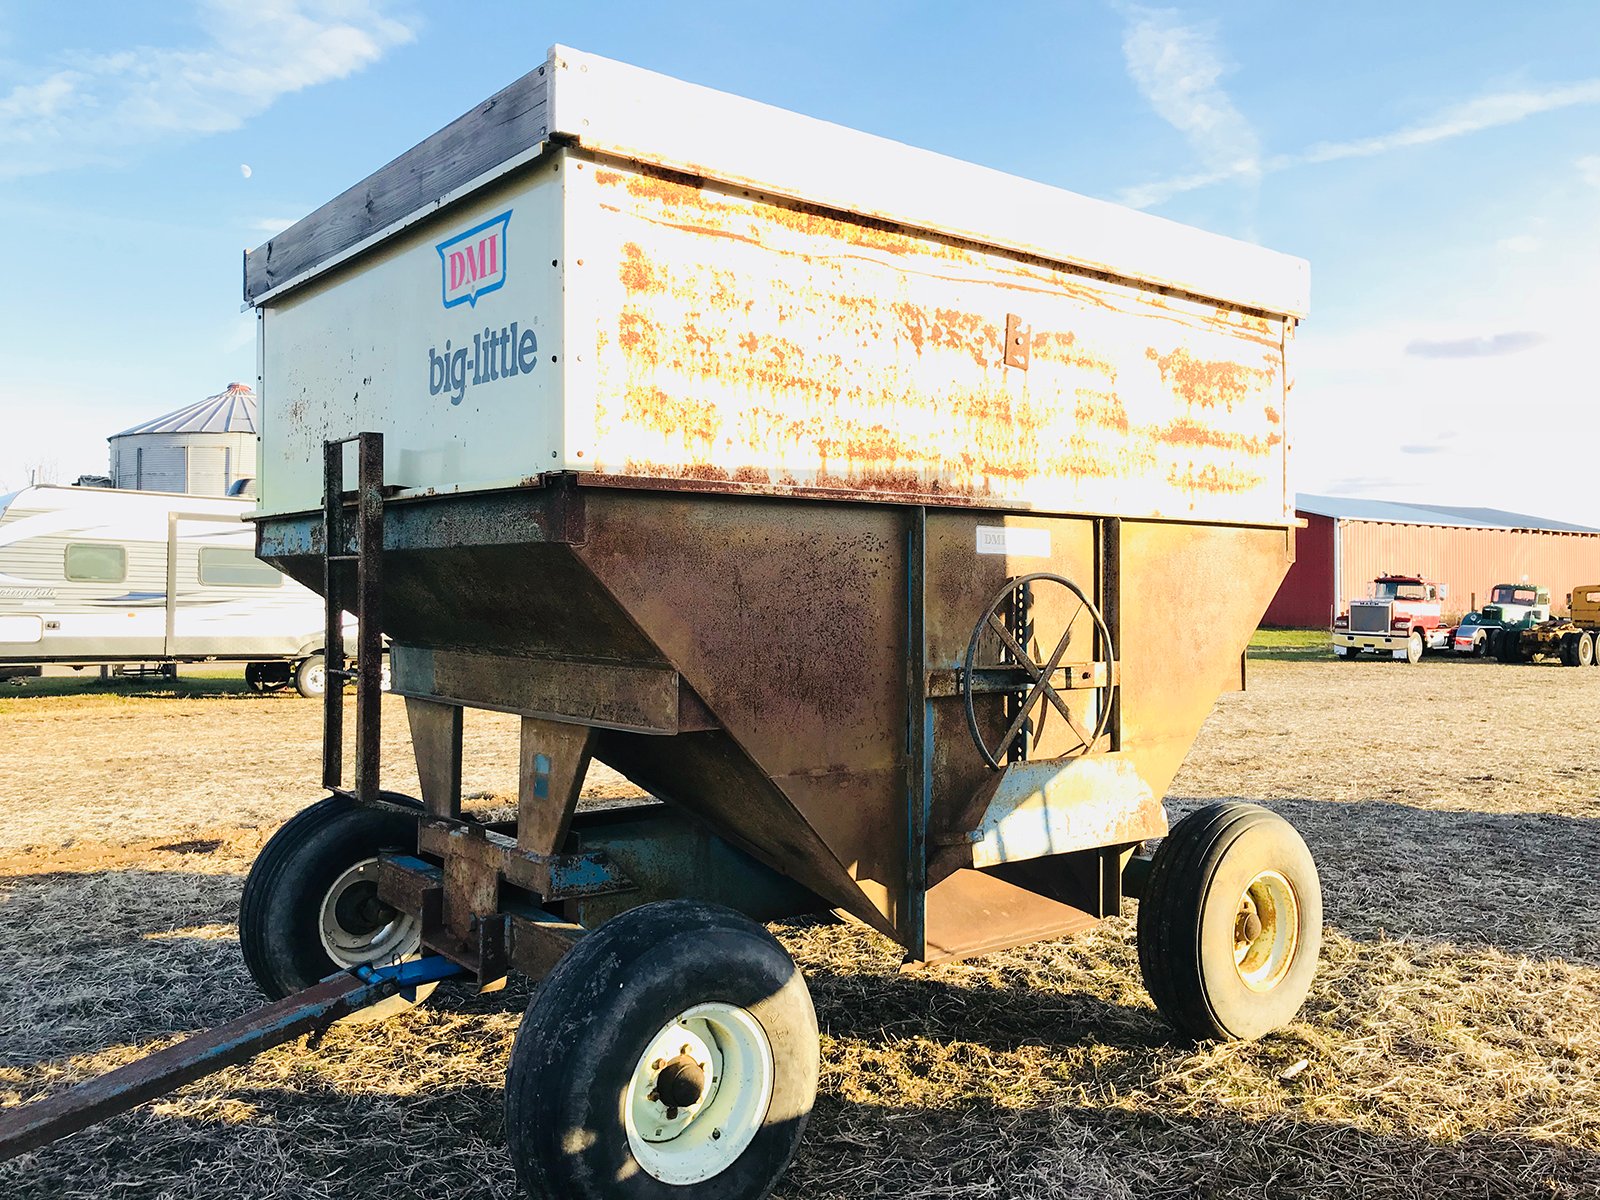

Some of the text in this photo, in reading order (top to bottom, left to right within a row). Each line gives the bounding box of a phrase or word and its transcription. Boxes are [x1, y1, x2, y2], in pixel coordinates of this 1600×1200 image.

[449, 234, 498, 291] DMI
[429, 322, 537, 406] big-little
[983, 533, 1006, 545] DMI
